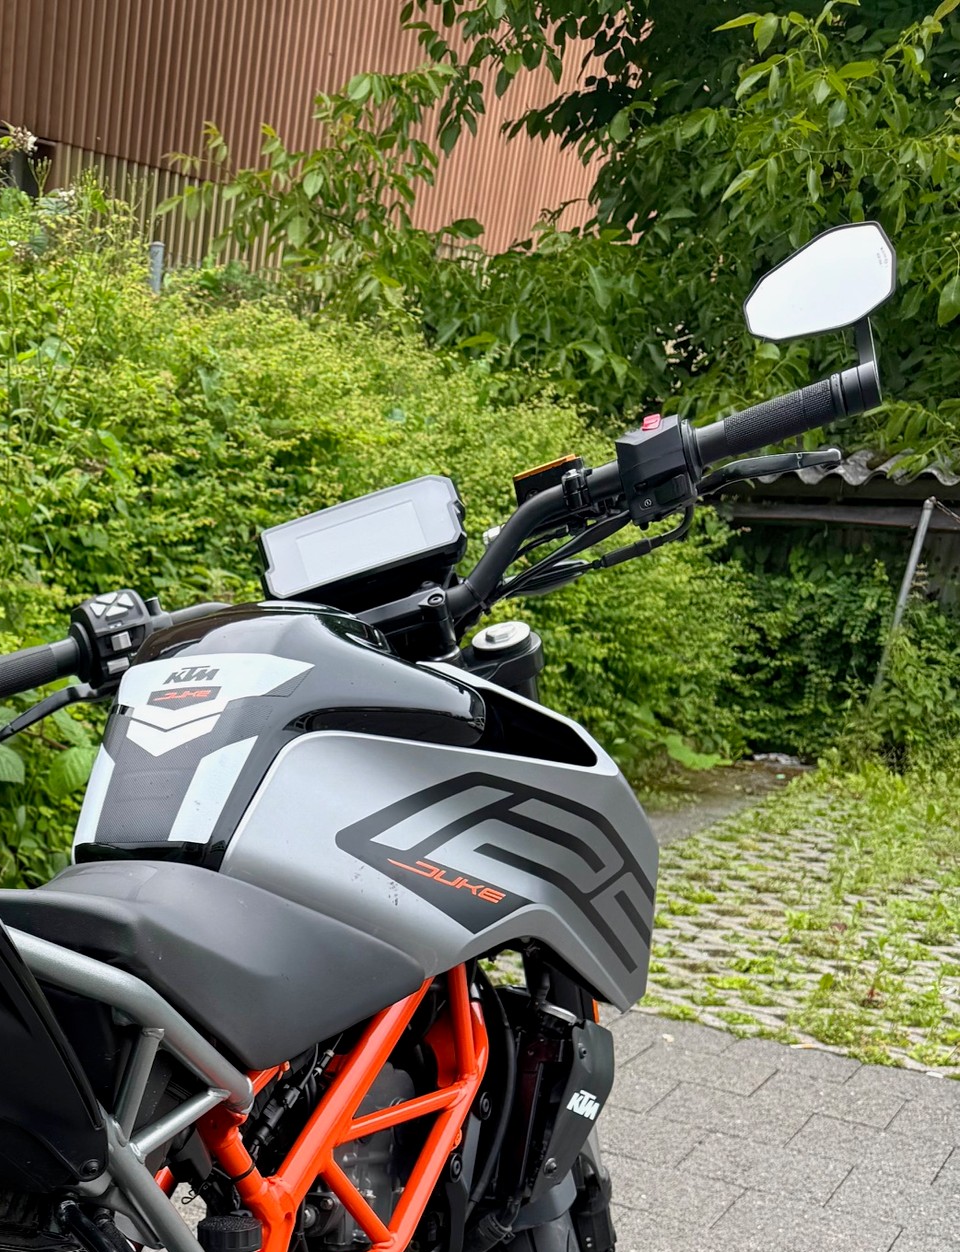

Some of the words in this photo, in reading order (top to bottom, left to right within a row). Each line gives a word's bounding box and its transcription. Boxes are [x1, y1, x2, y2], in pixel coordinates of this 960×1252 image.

[163, 665, 220, 685] KTM
[153, 690, 211, 701] DUKE
[387, 858, 506, 904] DUKE
[566, 1089, 600, 1121] KTM
